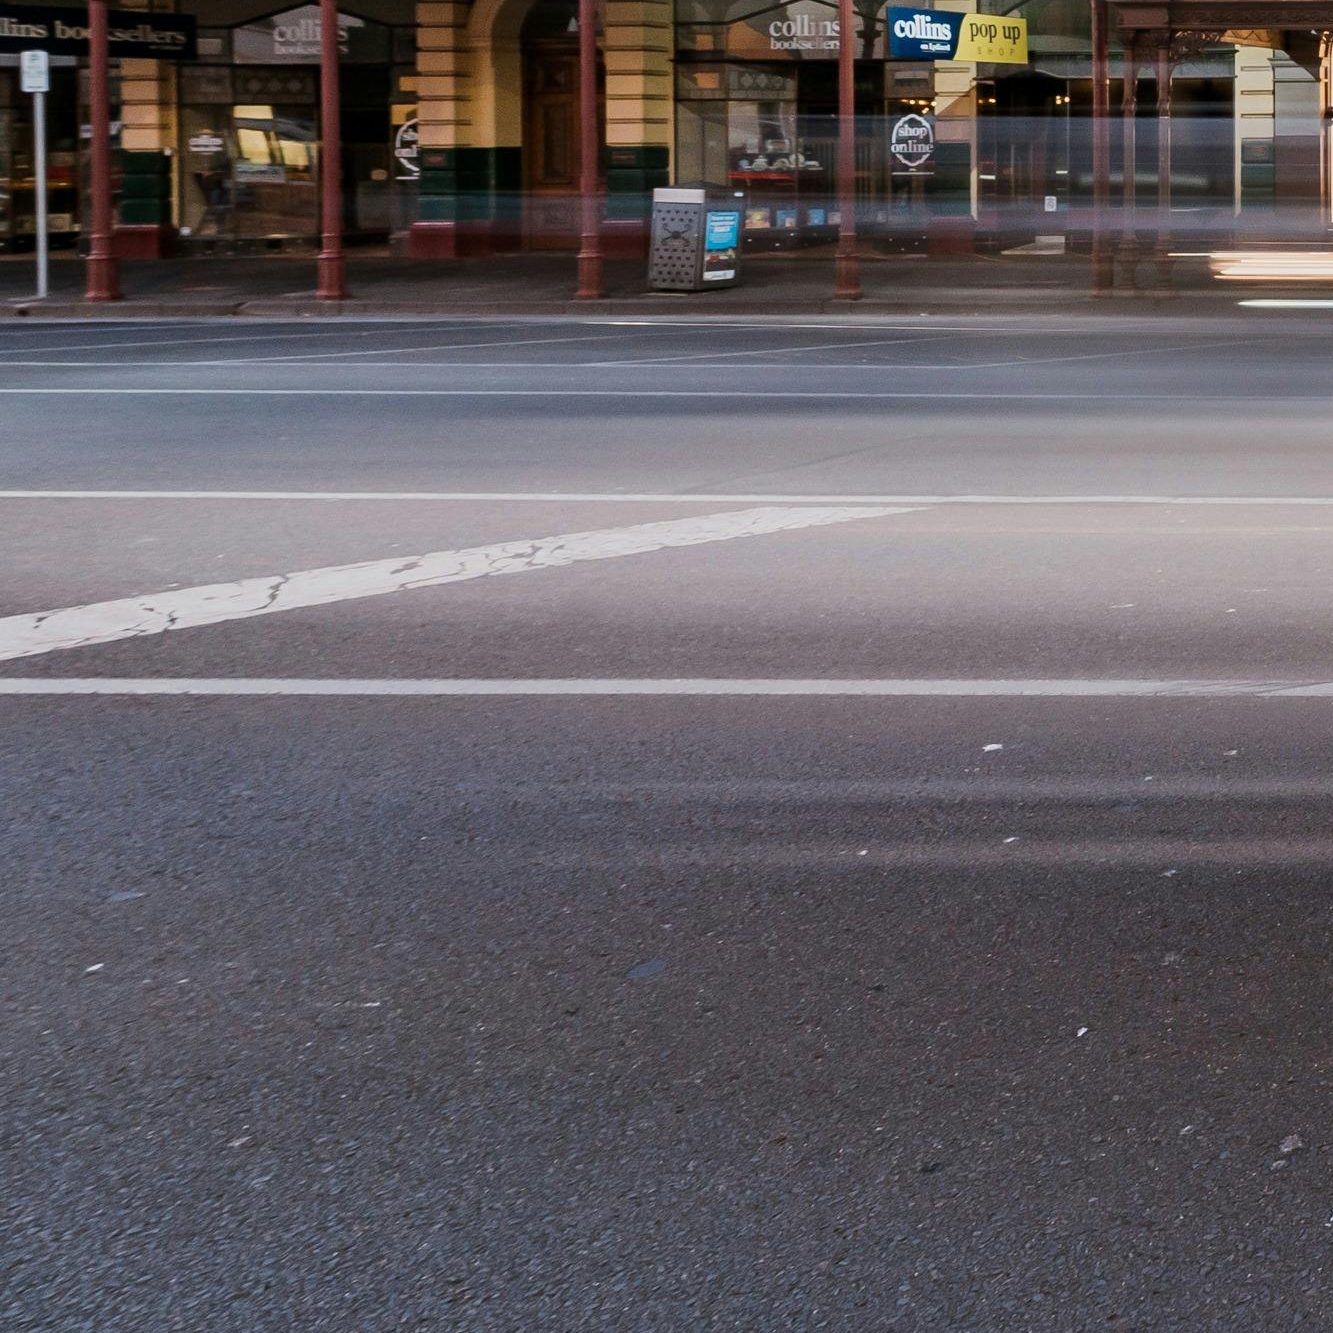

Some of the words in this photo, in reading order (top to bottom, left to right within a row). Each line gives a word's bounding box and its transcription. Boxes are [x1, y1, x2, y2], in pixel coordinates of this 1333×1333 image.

[769, 14, 840, 36] collins
[894, 14, 952, 41] collins
[970, 22, 997, 43] pop
[1003, 25, 1021, 45] up
[899, 124, 928, 139] shop
[891, 140, 934, 153] online
